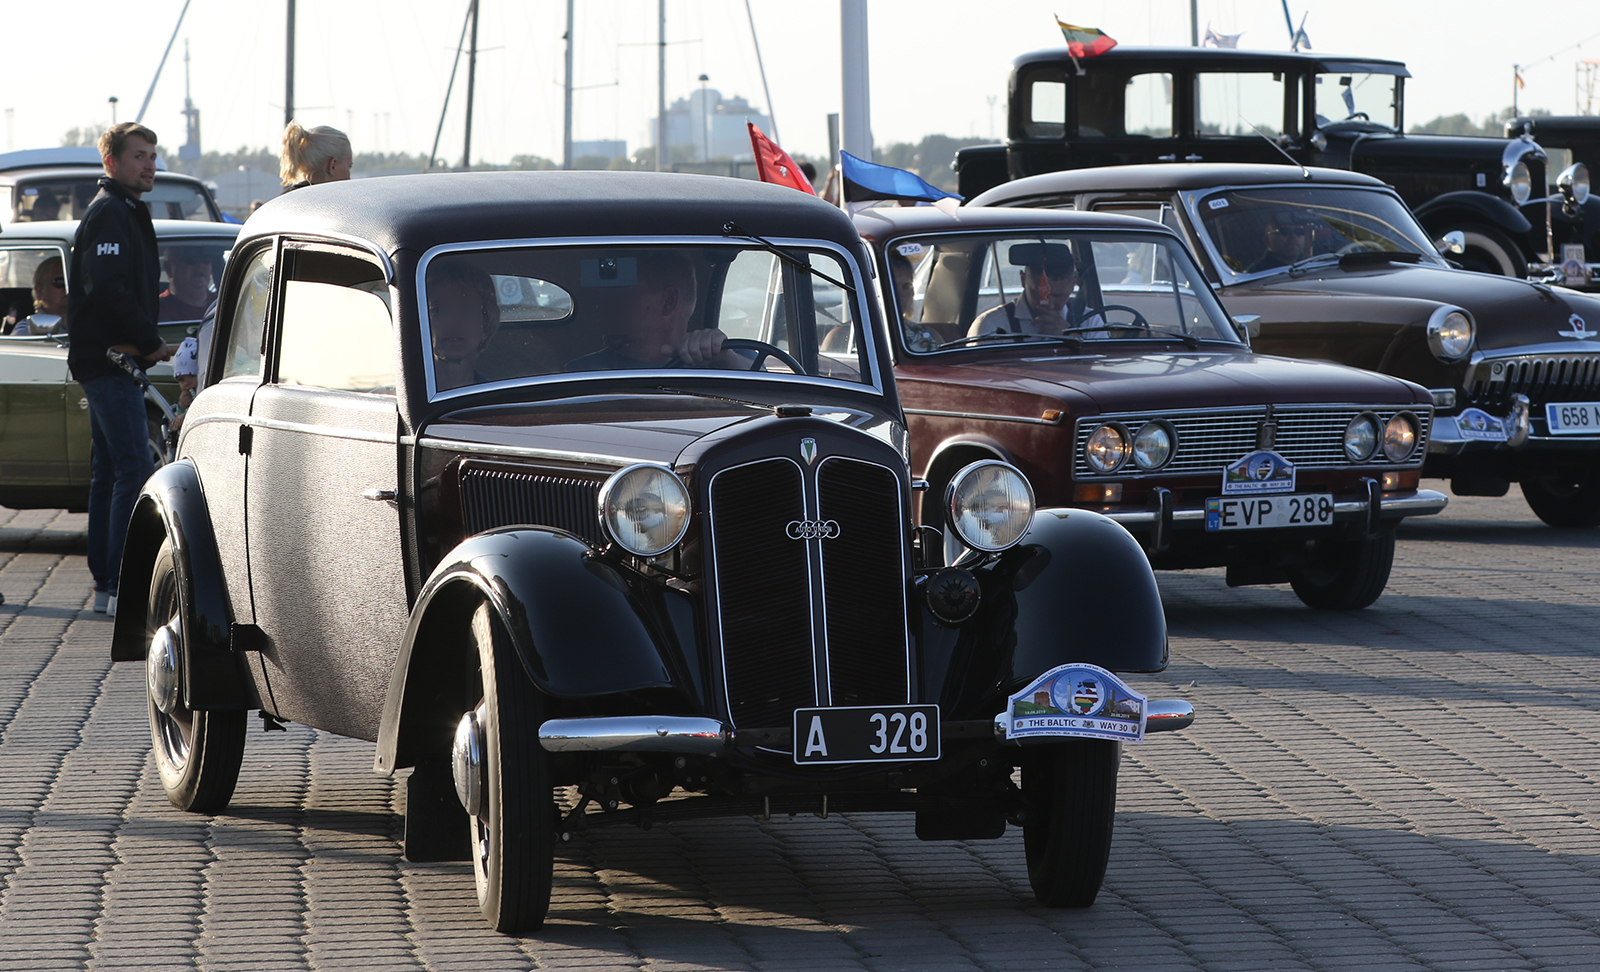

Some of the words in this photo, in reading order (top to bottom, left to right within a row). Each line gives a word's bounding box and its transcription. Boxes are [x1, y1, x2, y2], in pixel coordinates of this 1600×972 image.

[97, 243, 119, 256] HH
[901, 245, 920, 253] 756
[1562, 407, 1589, 426] 658
[1222, 500, 1272, 526] EVP
[1289, 497, 1329, 523] 288
[1029, 719, 1045, 727] THE
[1047, 719, 1076, 727] BALTIC
[1100, 721, 1117, 731] WAY
[1118, 724, 1128, 732] 30
[804, 715, 828, 757] A
[869, 711, 928, 754] 328
